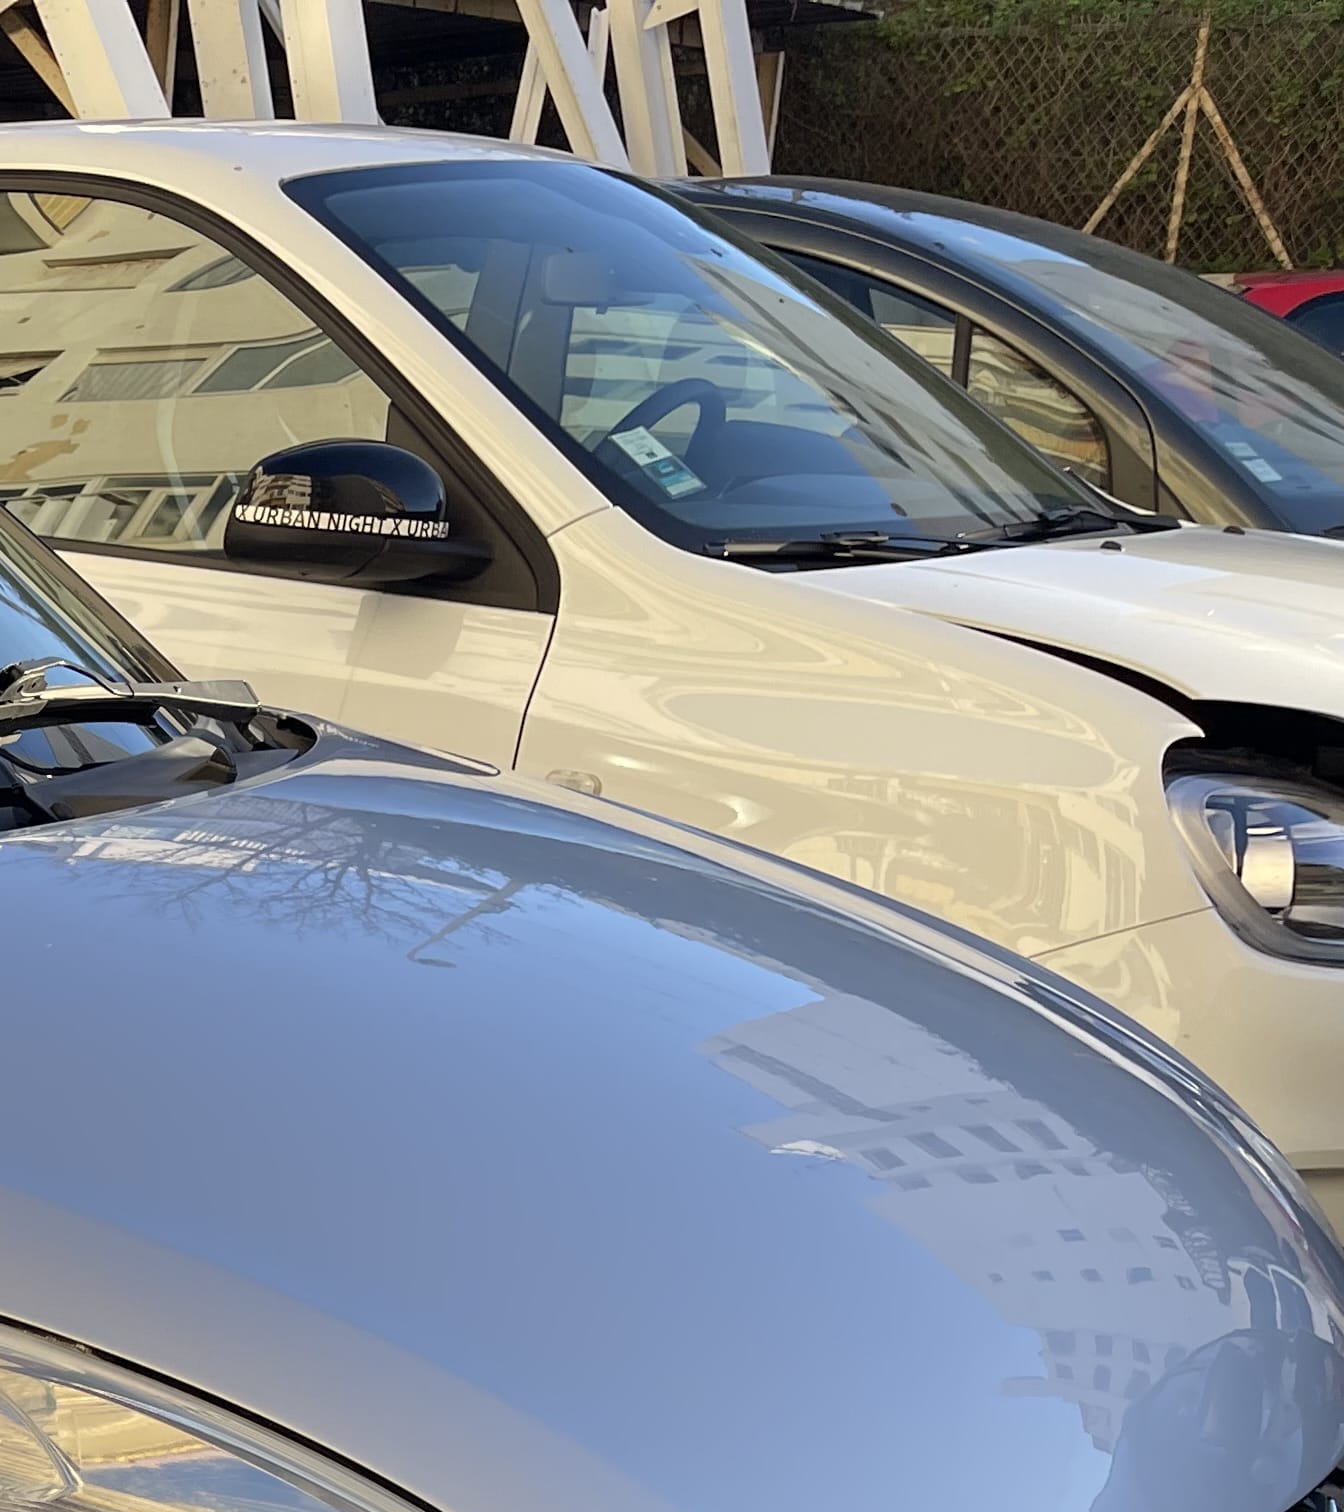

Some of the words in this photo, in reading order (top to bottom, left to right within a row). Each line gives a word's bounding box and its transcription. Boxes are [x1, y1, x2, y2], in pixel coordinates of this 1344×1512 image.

[238, 505, 249, 521] X
[254, 505, 320, 529] URBAN
[327, 511, 388, 535] NIGHT
[391, 517, 403, 537] X
